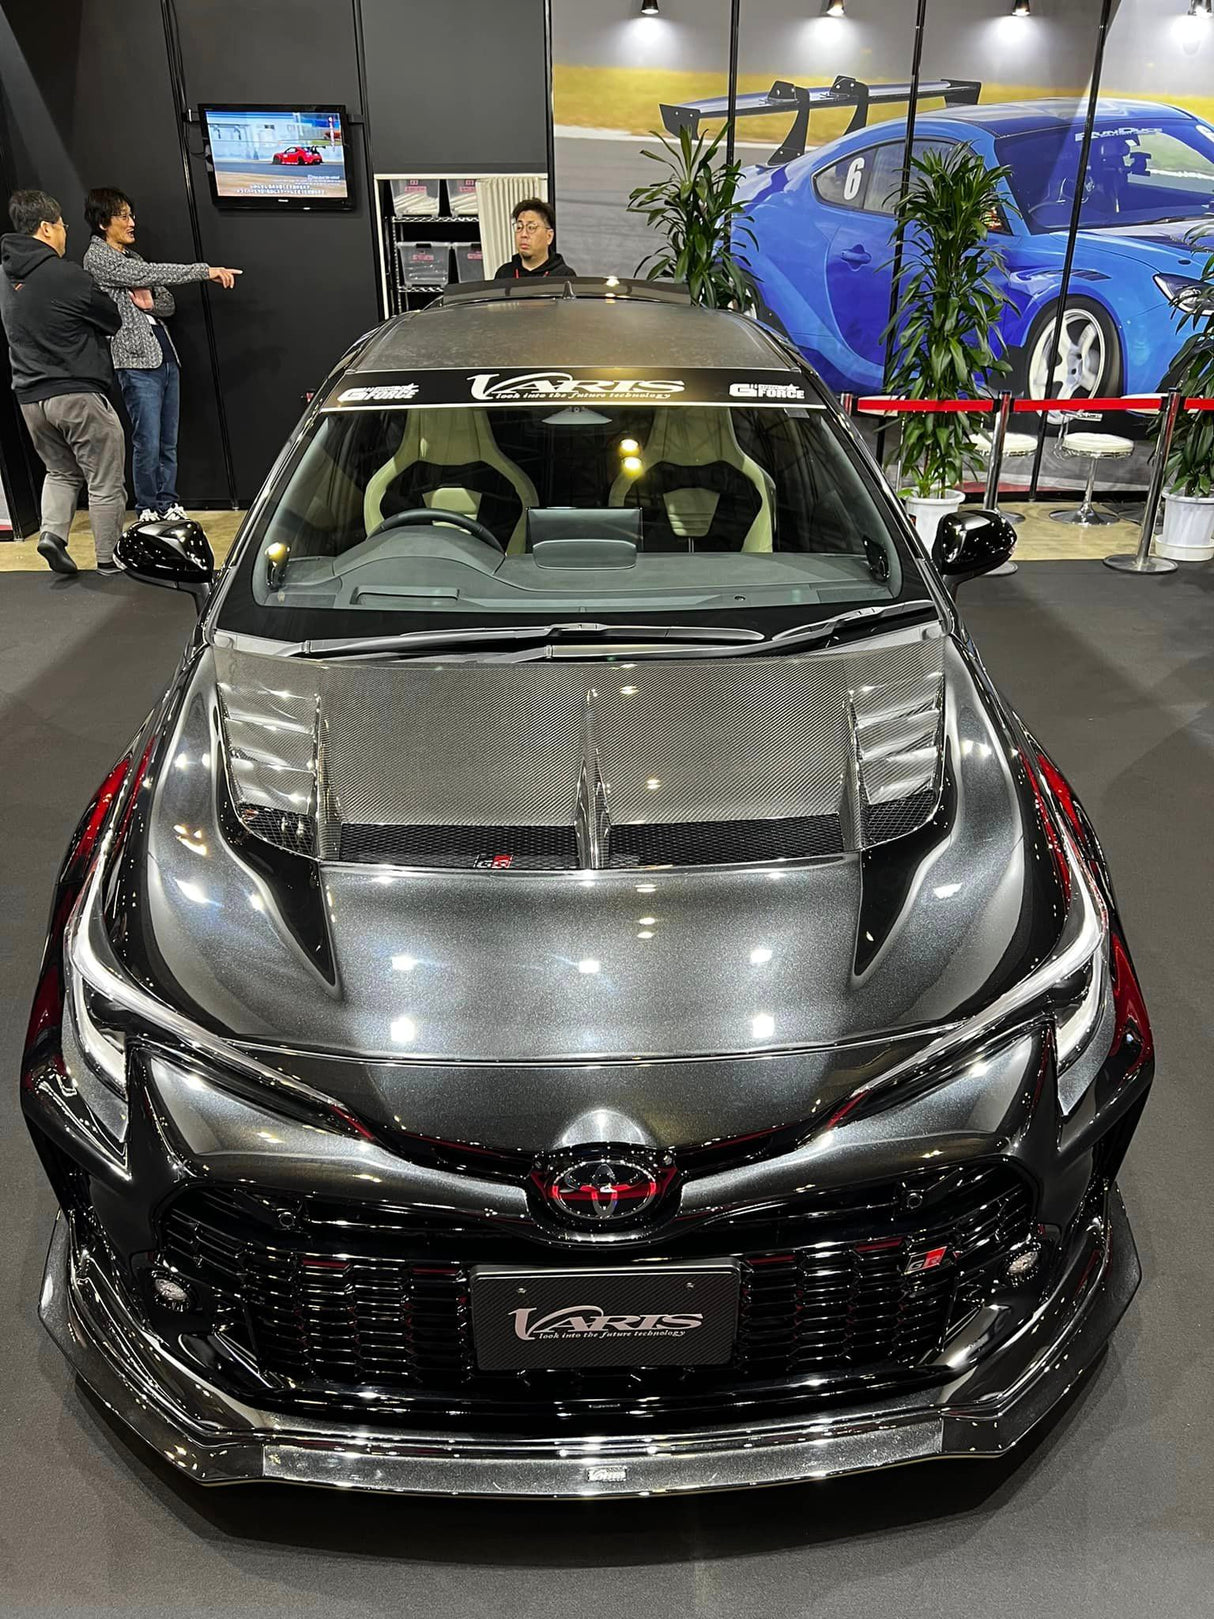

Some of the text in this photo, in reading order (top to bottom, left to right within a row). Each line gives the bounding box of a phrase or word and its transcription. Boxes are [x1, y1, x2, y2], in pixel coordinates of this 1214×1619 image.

[844, 156, 865, 200] 6
[466, 372, 685, 400] VARIS
[508, 1305, 703, 1340] VARIS
[598, 1331, 631, 1339] future
[634, 1329, 686, 1338] technology
